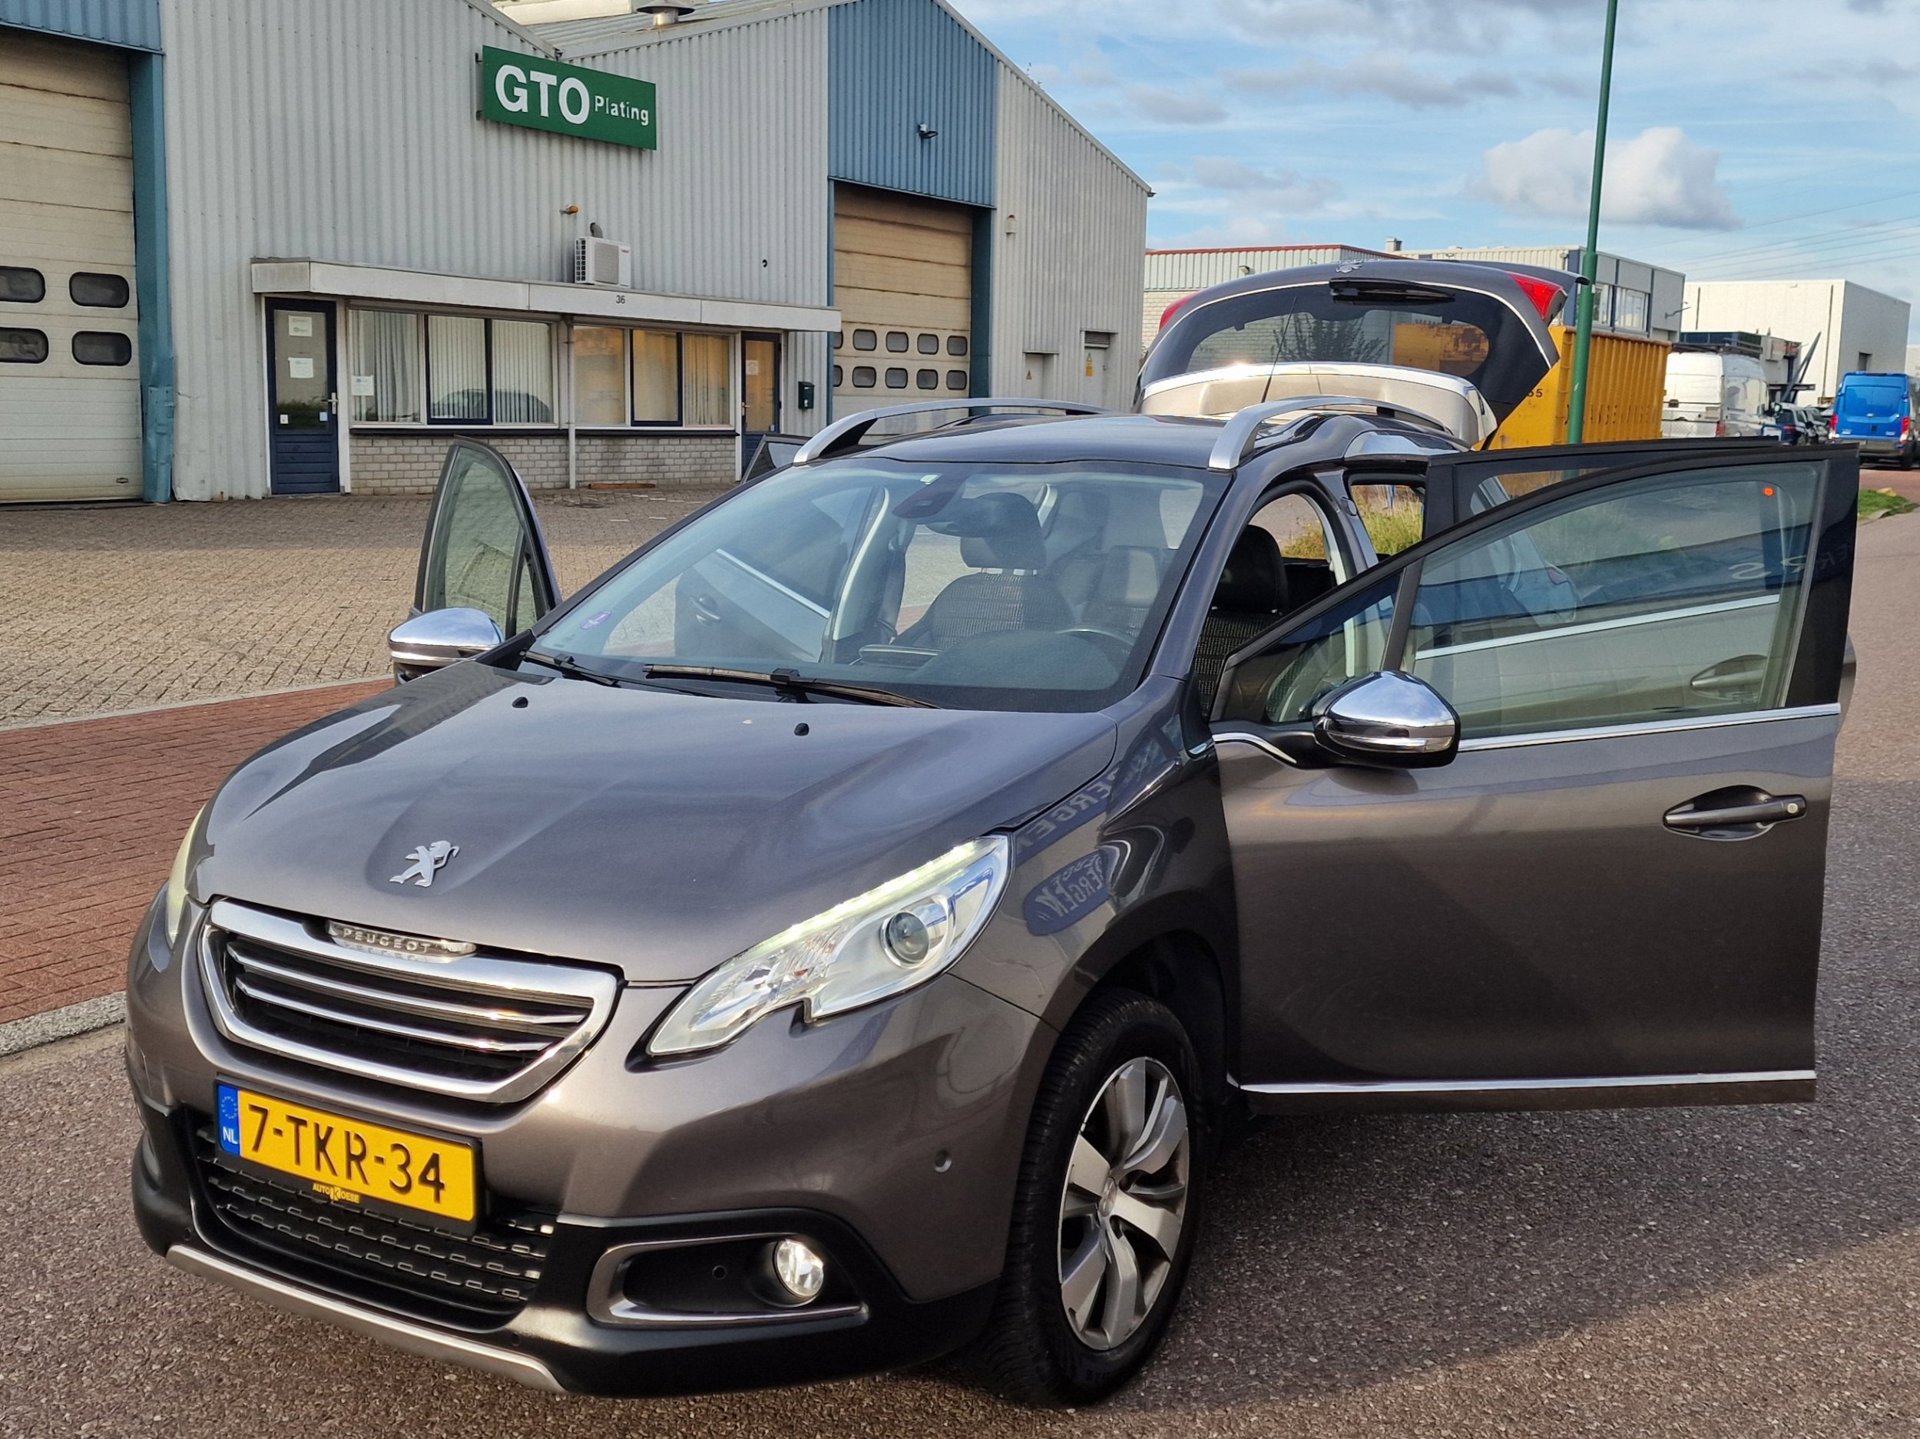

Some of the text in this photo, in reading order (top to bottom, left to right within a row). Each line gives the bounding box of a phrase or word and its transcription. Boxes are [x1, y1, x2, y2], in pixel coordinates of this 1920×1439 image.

[495, 64, 649, 126] GTO Plating
[615, 294, 626, 305] 36
[342, 927, 431, 953] PEUGEOT
[222, 1126, 239, 1146] NL
[248, 1103, 446, 1205] 7-TKR-34
